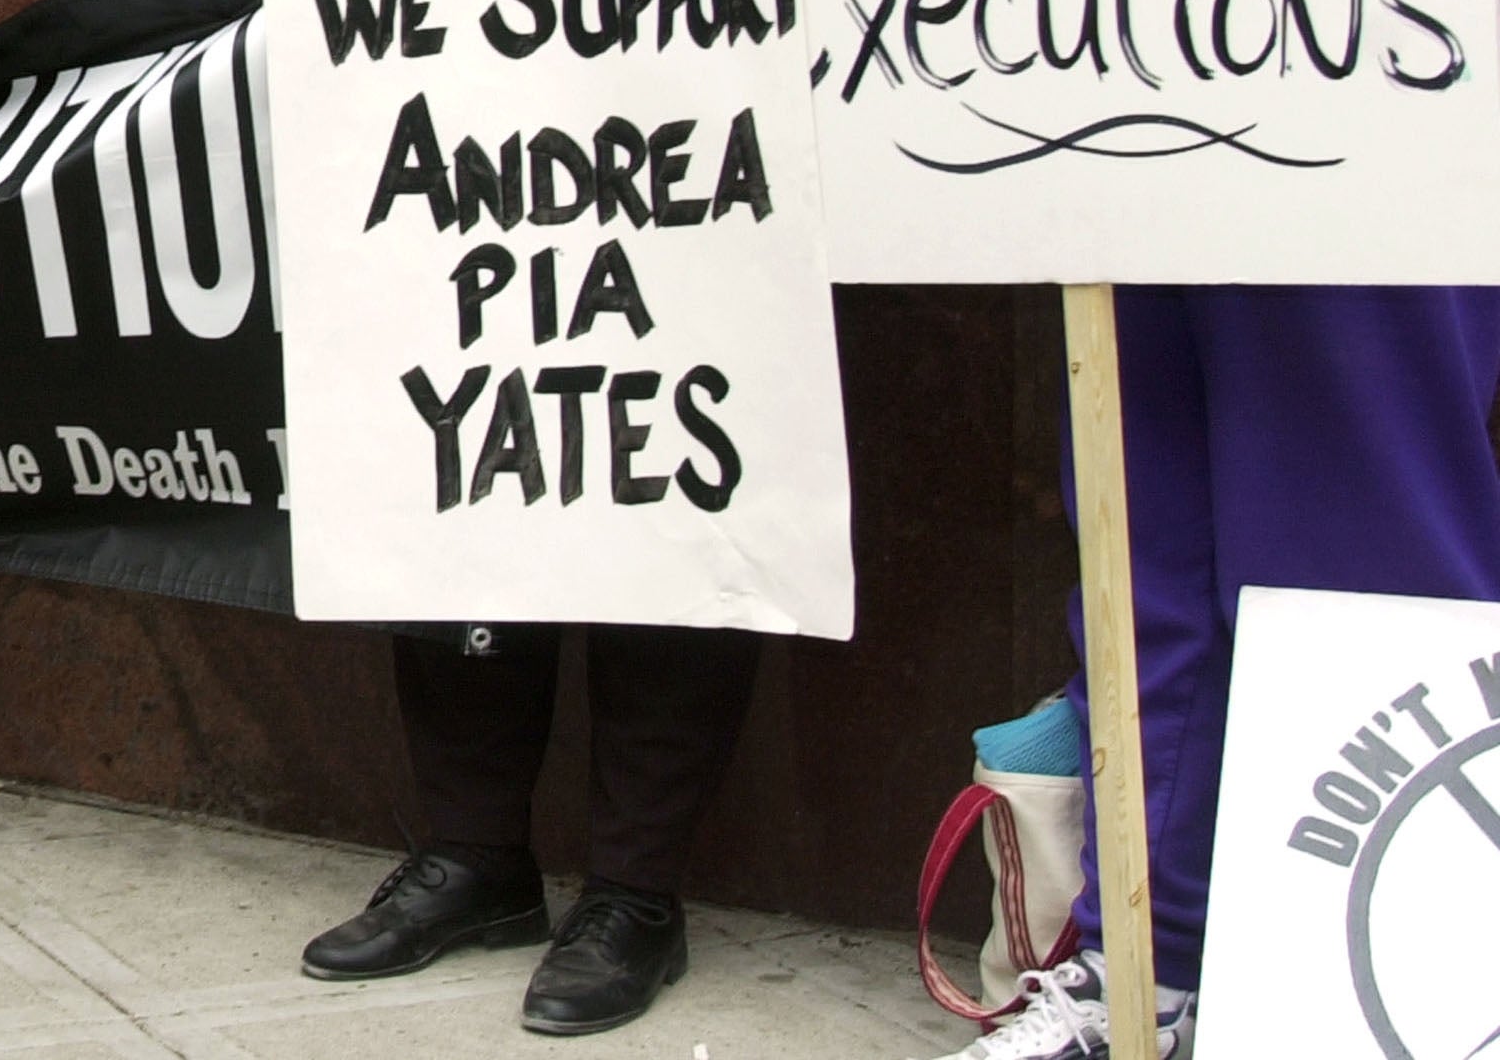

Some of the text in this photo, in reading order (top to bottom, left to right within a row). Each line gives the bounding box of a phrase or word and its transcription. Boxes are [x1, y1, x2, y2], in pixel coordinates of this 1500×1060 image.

[363, 92, 774, 234] ANDREA
[450, 239, 656, 349] PIA
[56, 426, 252, 506] Death
[399, 364, 742, 514] YATES
[1287, 682, 1453, 867] DON'T
